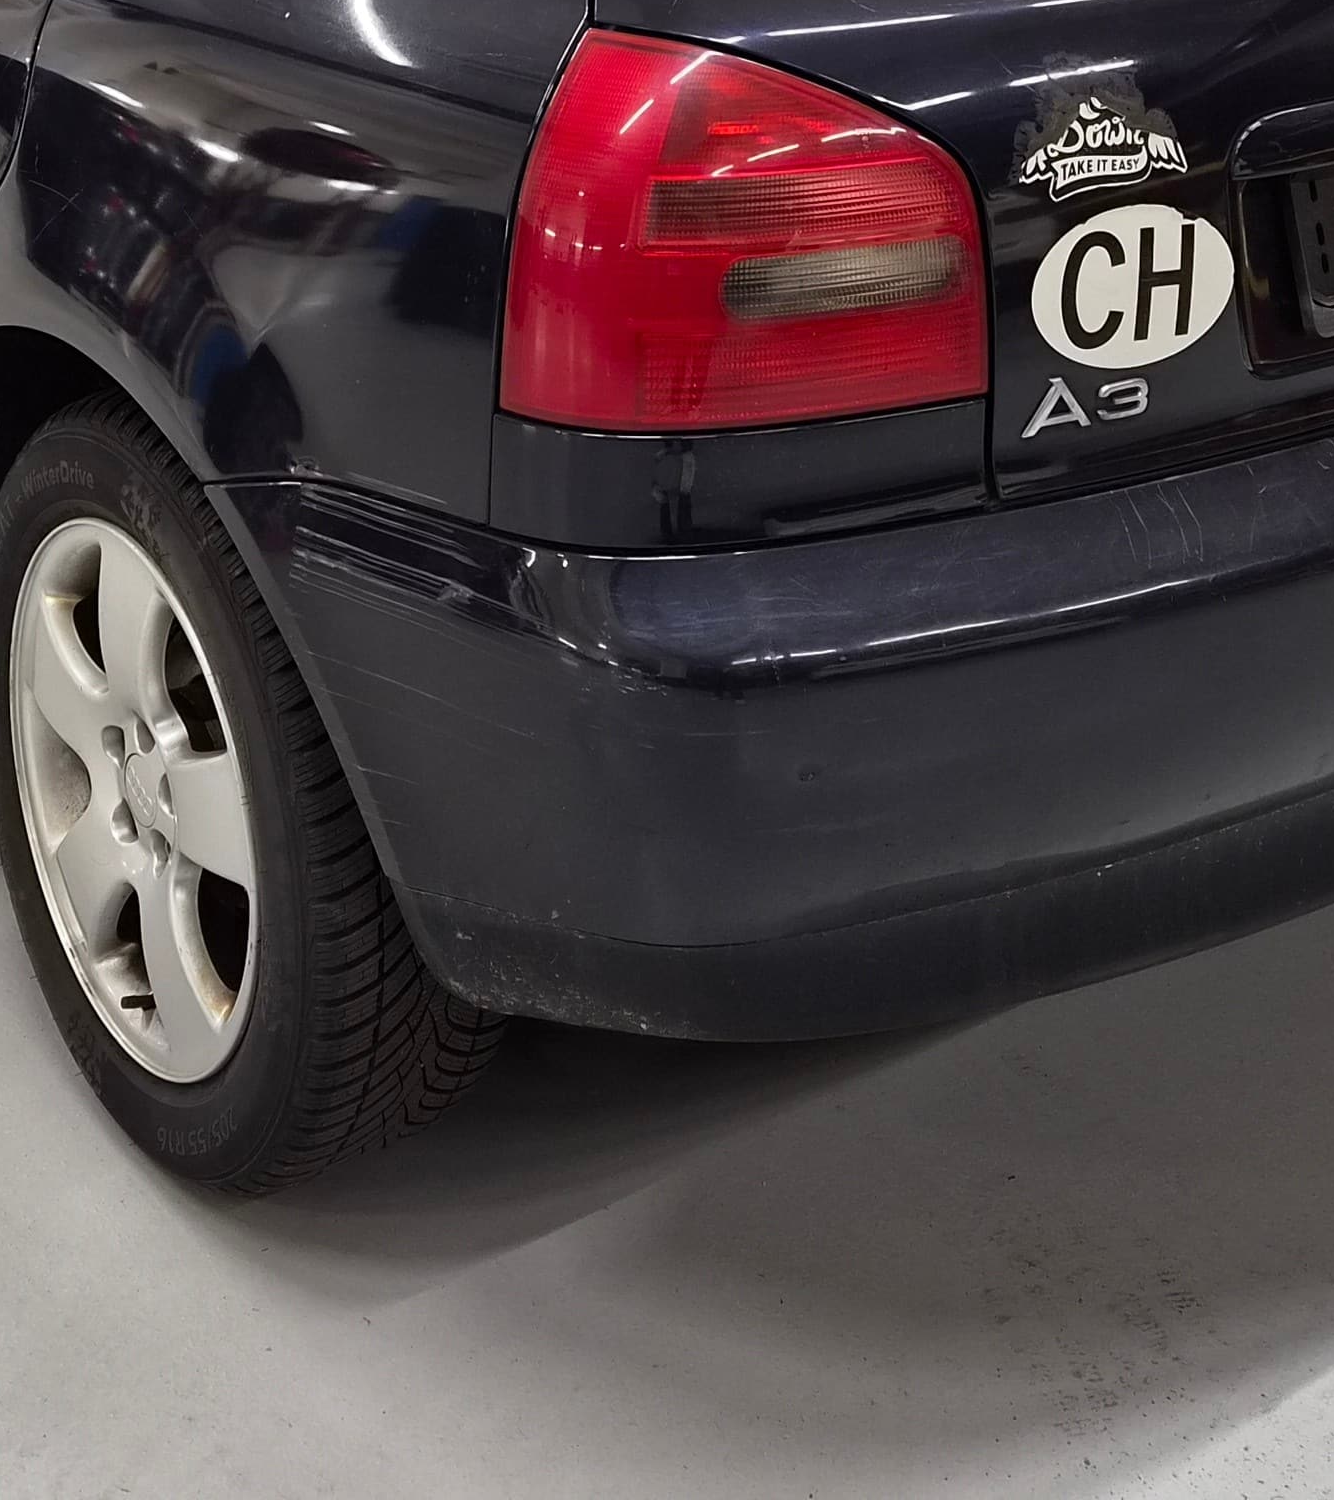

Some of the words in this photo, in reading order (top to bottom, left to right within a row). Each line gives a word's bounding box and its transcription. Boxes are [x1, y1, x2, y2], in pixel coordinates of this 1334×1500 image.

[1060, 159, 1093, 181] TAKE
[1097, 159, 1107, 172] IT
[1111, 157, 1140, 172] EASY
[1060, 222, 1196, 351] CH
[1020, 376, 1149, 439] A3
[20, 459, 95, 500] WinterDrive
